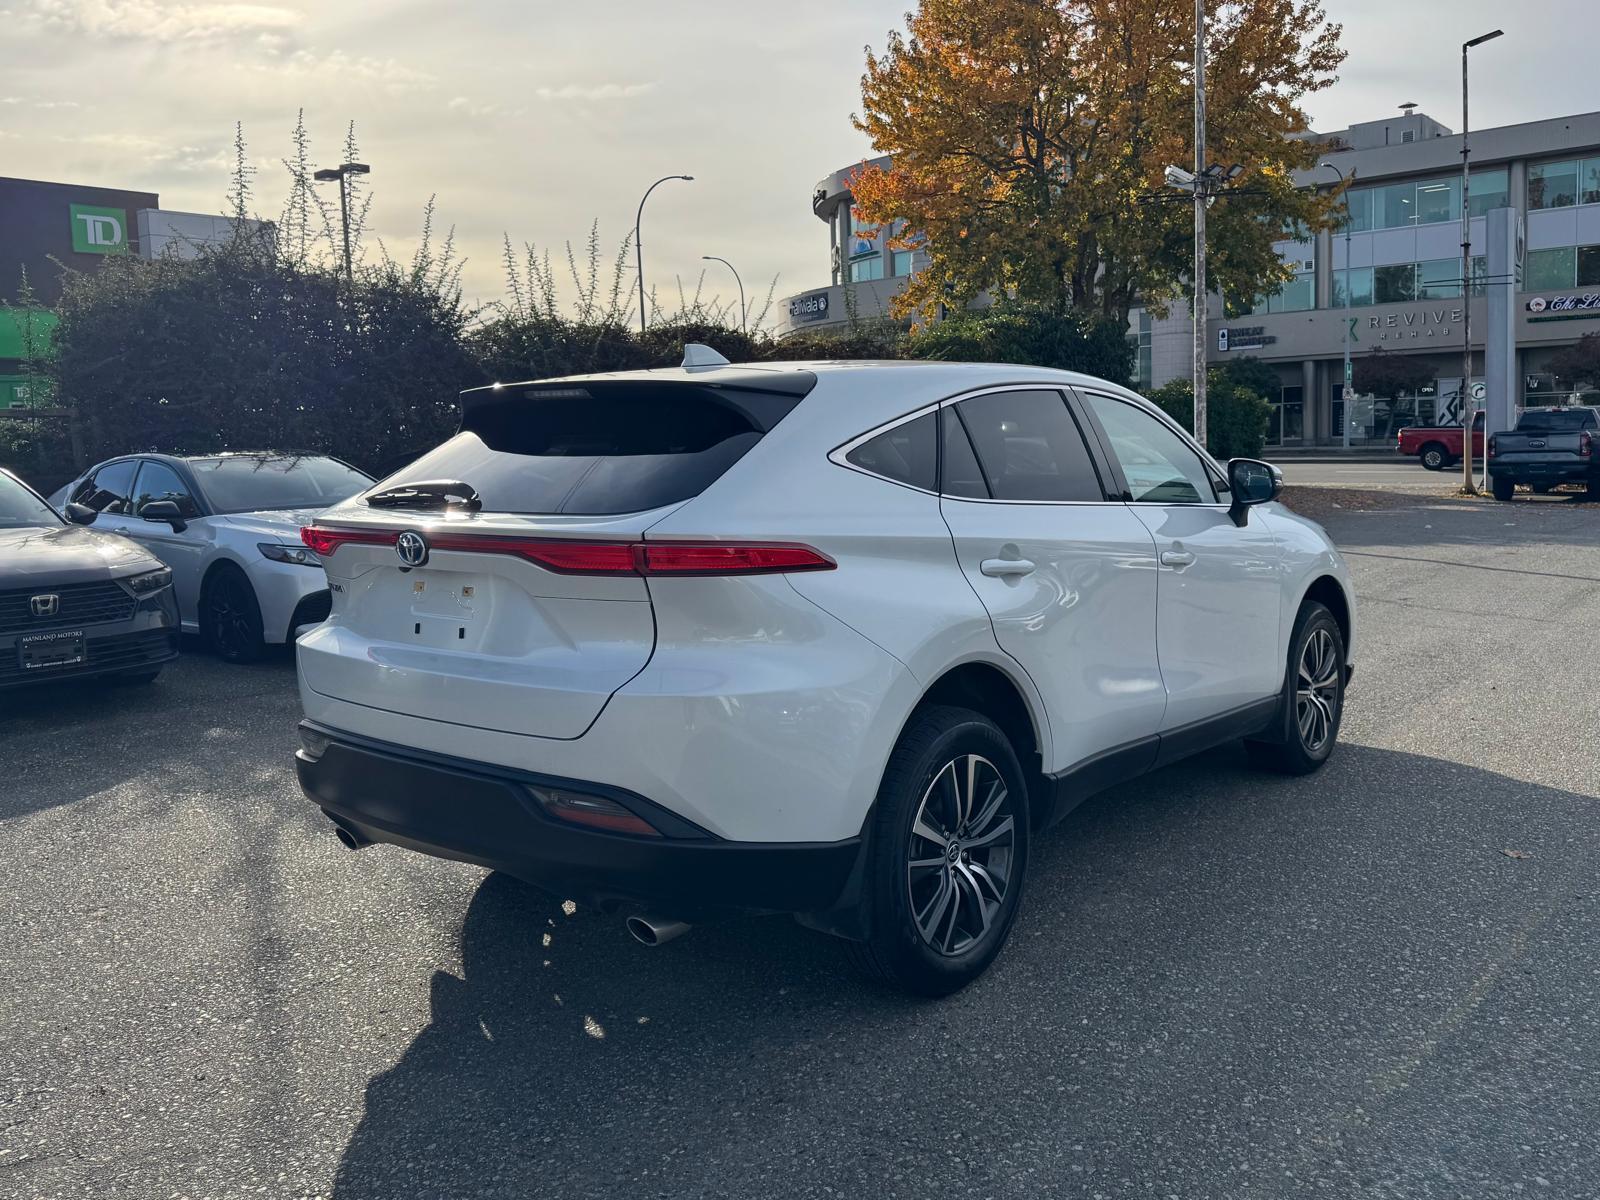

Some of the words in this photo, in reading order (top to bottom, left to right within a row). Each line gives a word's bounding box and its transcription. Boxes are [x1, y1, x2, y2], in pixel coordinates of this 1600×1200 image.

[77, 214, 122, 246] TD
[1368, 309, 1463, 328] REVIVE
[1380, 328, 1450, 340] REHAB
[329, 583, 345, 593] NZA
